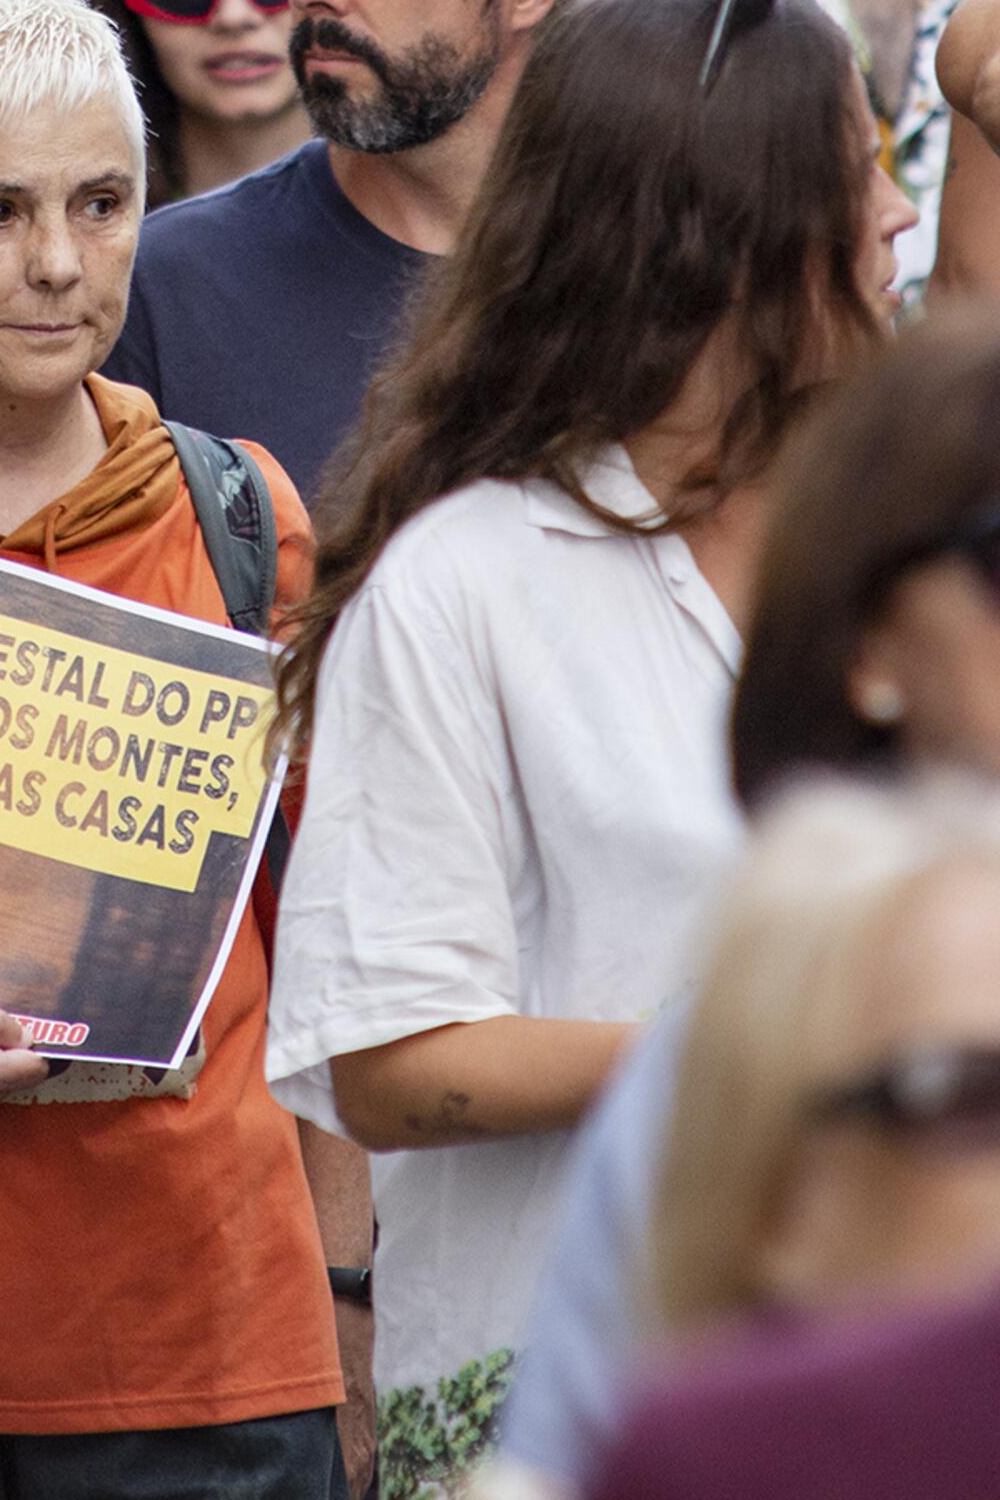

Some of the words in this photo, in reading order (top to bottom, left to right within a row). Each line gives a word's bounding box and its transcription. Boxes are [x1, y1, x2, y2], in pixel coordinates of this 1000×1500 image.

[121, 670, 191, 726] DO
[199, 689, 259, 740] PP
[44, 713, 239, 812] MONTES,
[55, 781, 200, 855] CASAS
